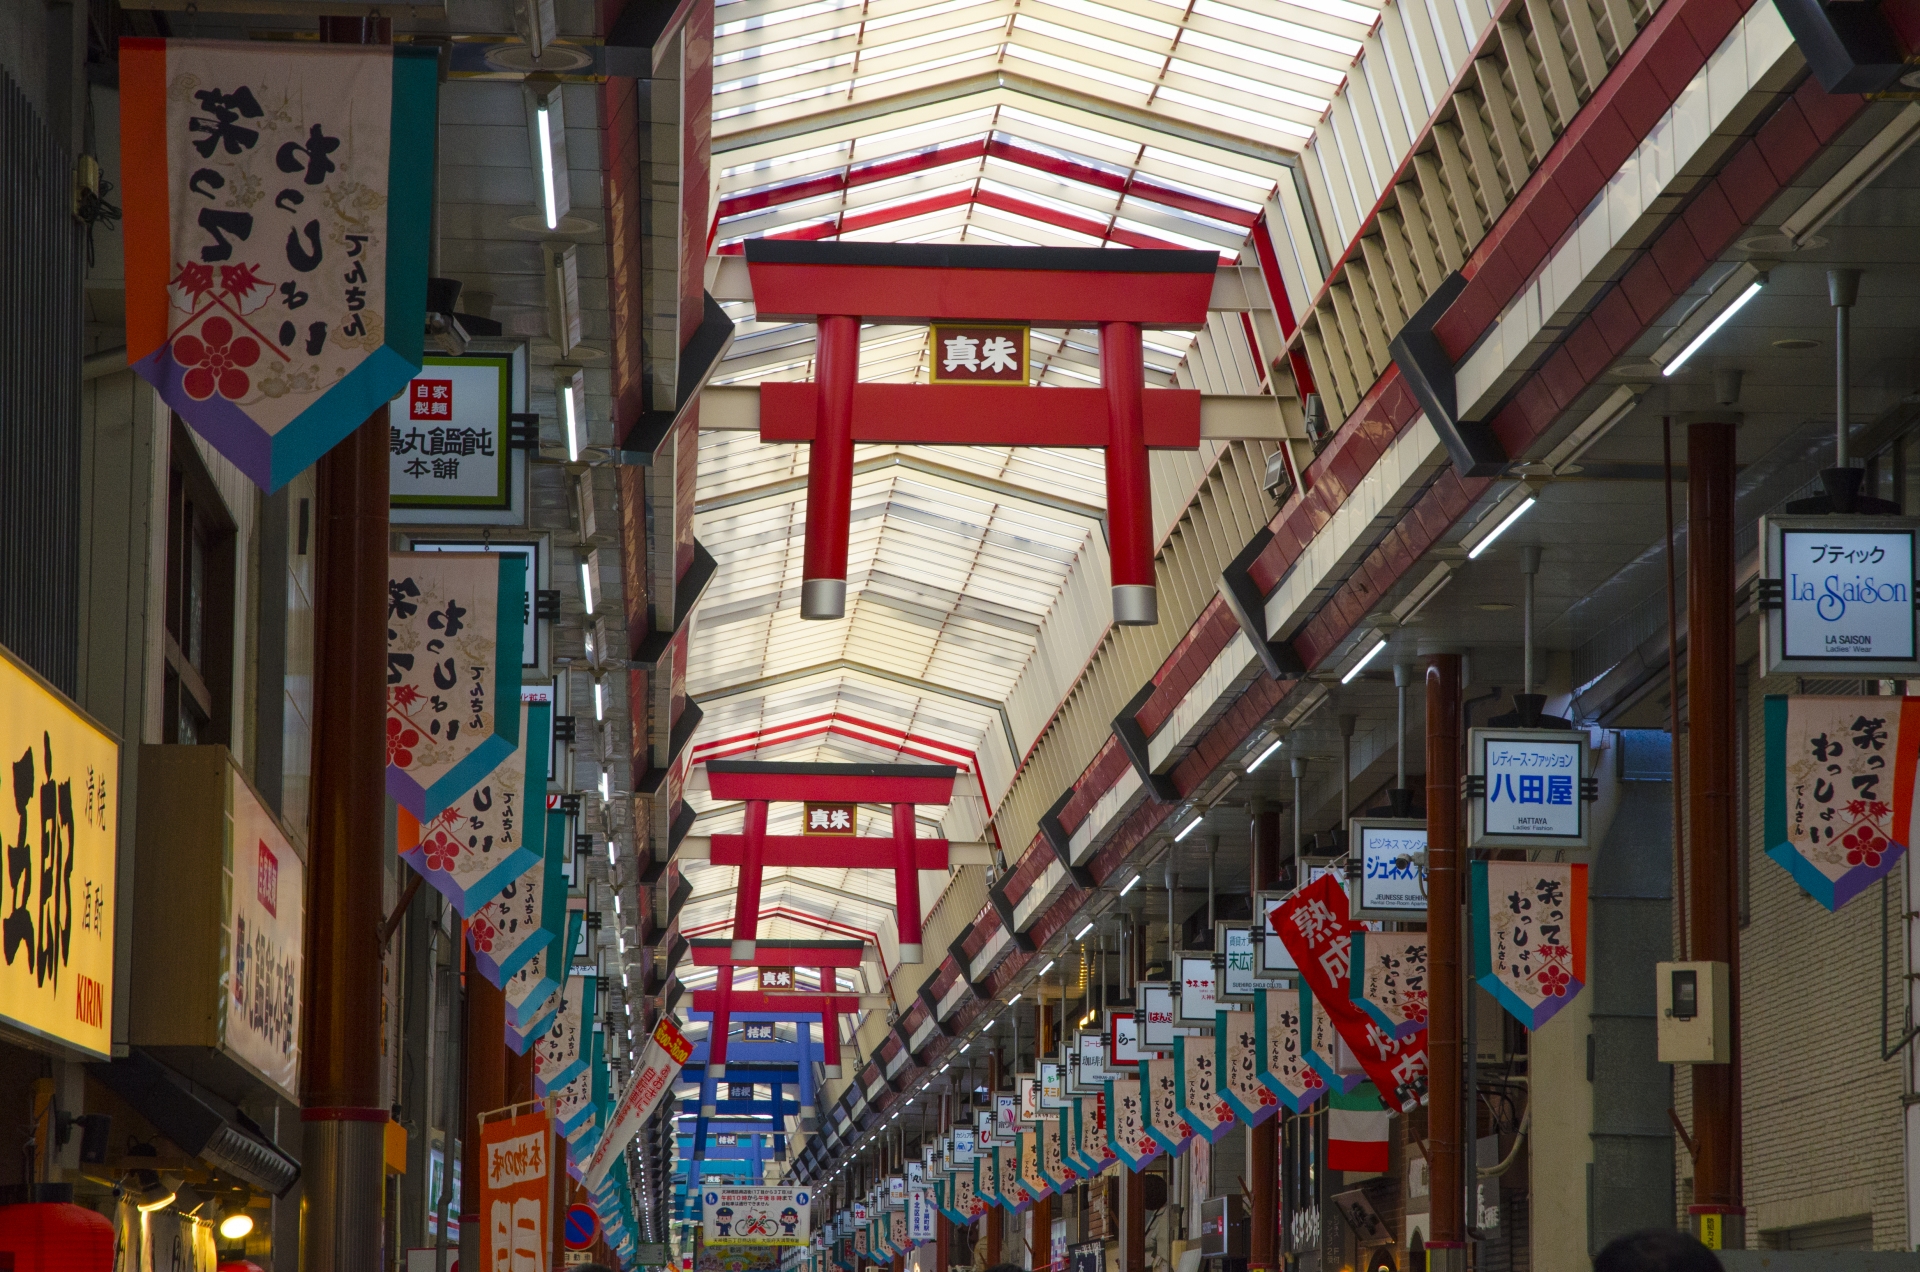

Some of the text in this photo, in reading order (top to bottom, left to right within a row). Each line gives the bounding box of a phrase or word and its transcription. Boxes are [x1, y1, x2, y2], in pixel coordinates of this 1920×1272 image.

[943, 335, 1018, 374] 真朱
[417, 384, 448, 399] 自家
[414, 401, 448, 415] 製麺
[404, 457, 460, 480] 本舗
[1810, 545, 1886, 565] ブティック
[1790, 573, 1815, 602] La
[1825, 635, 1872, 645] LA SAISON
[1825, 645, 1872, 653] Ladies' Wear
[1491, 751, 1574, 769] レディース・ファッション
[1851, 716, 1888, 800] 笑って
[1490, 774, 1574, 806] 八田屋
[1810, 733, 1844, 844] わっしょい
[810, 808, 850, 830] 真朱
[1517, 817, 1548, 826] HATTAYA
[1794, 784, 1804, 836] てんさん
[1369, 838, 1399, 850] ビジネス
[1535, 878, 1564, 945] 笑って
[1497, 931, 1506, 970] てんさん
[1508, 891, 1532, 978] わっしょい
[1369, 977, 1378, 998] てんさん
[1381, 954, 1401, 1005] わっしょい
[76, 972, 103, 1030] KIRIN
[1118, 1032, 1136, 1046] らー
[1280, 1010, 1299, 1076] わっしょい
[1196, 1055, 1212, 1111] わっしょい
[1160, 1076, 1175, 1128] わっしょい
[1123, 1096, 1136, 1145] わっしょい
